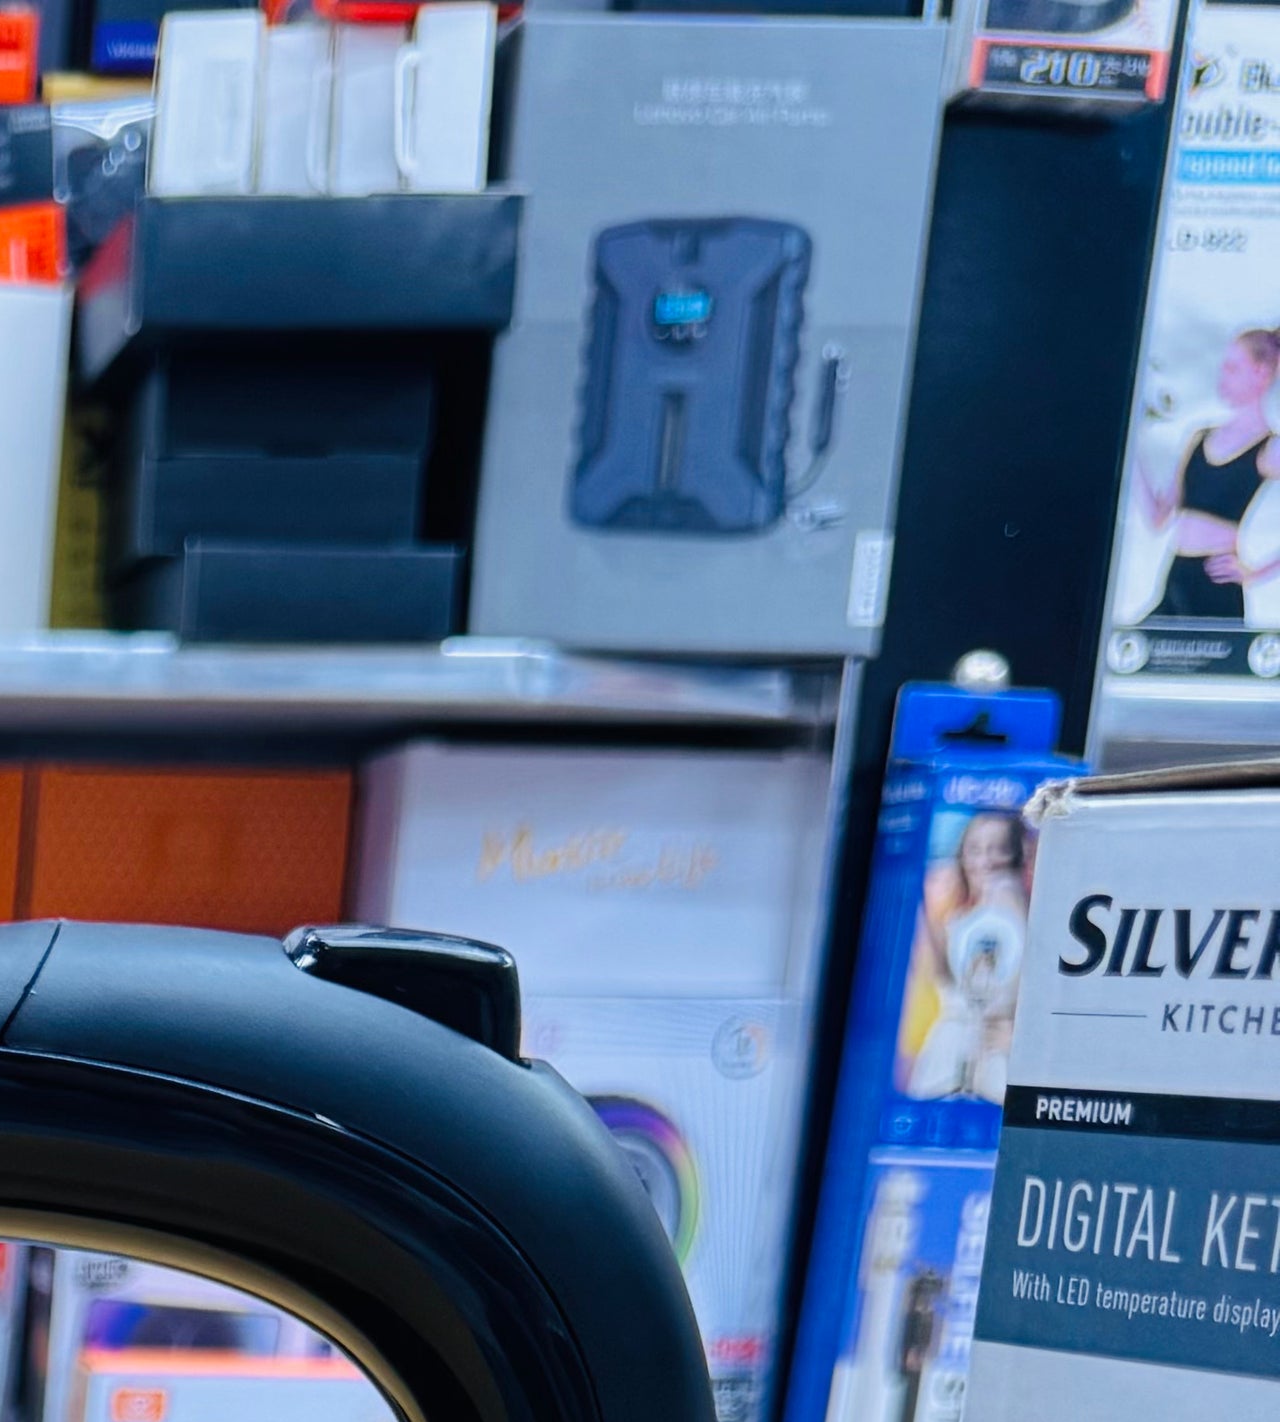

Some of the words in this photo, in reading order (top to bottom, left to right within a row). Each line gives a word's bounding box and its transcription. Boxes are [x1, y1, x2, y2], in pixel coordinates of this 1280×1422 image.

[1036, 1097, 1132, 1126] PREMIUM
[1017, 1177, 1181, 1264] DIGITAL
[1012, 1269, 1050, 1302] With
[1057, 1276, 1090, 1307] LED
[1096, 1282, 1206, 1321] temperature
[1213, 1294, 1280, 1338] display
